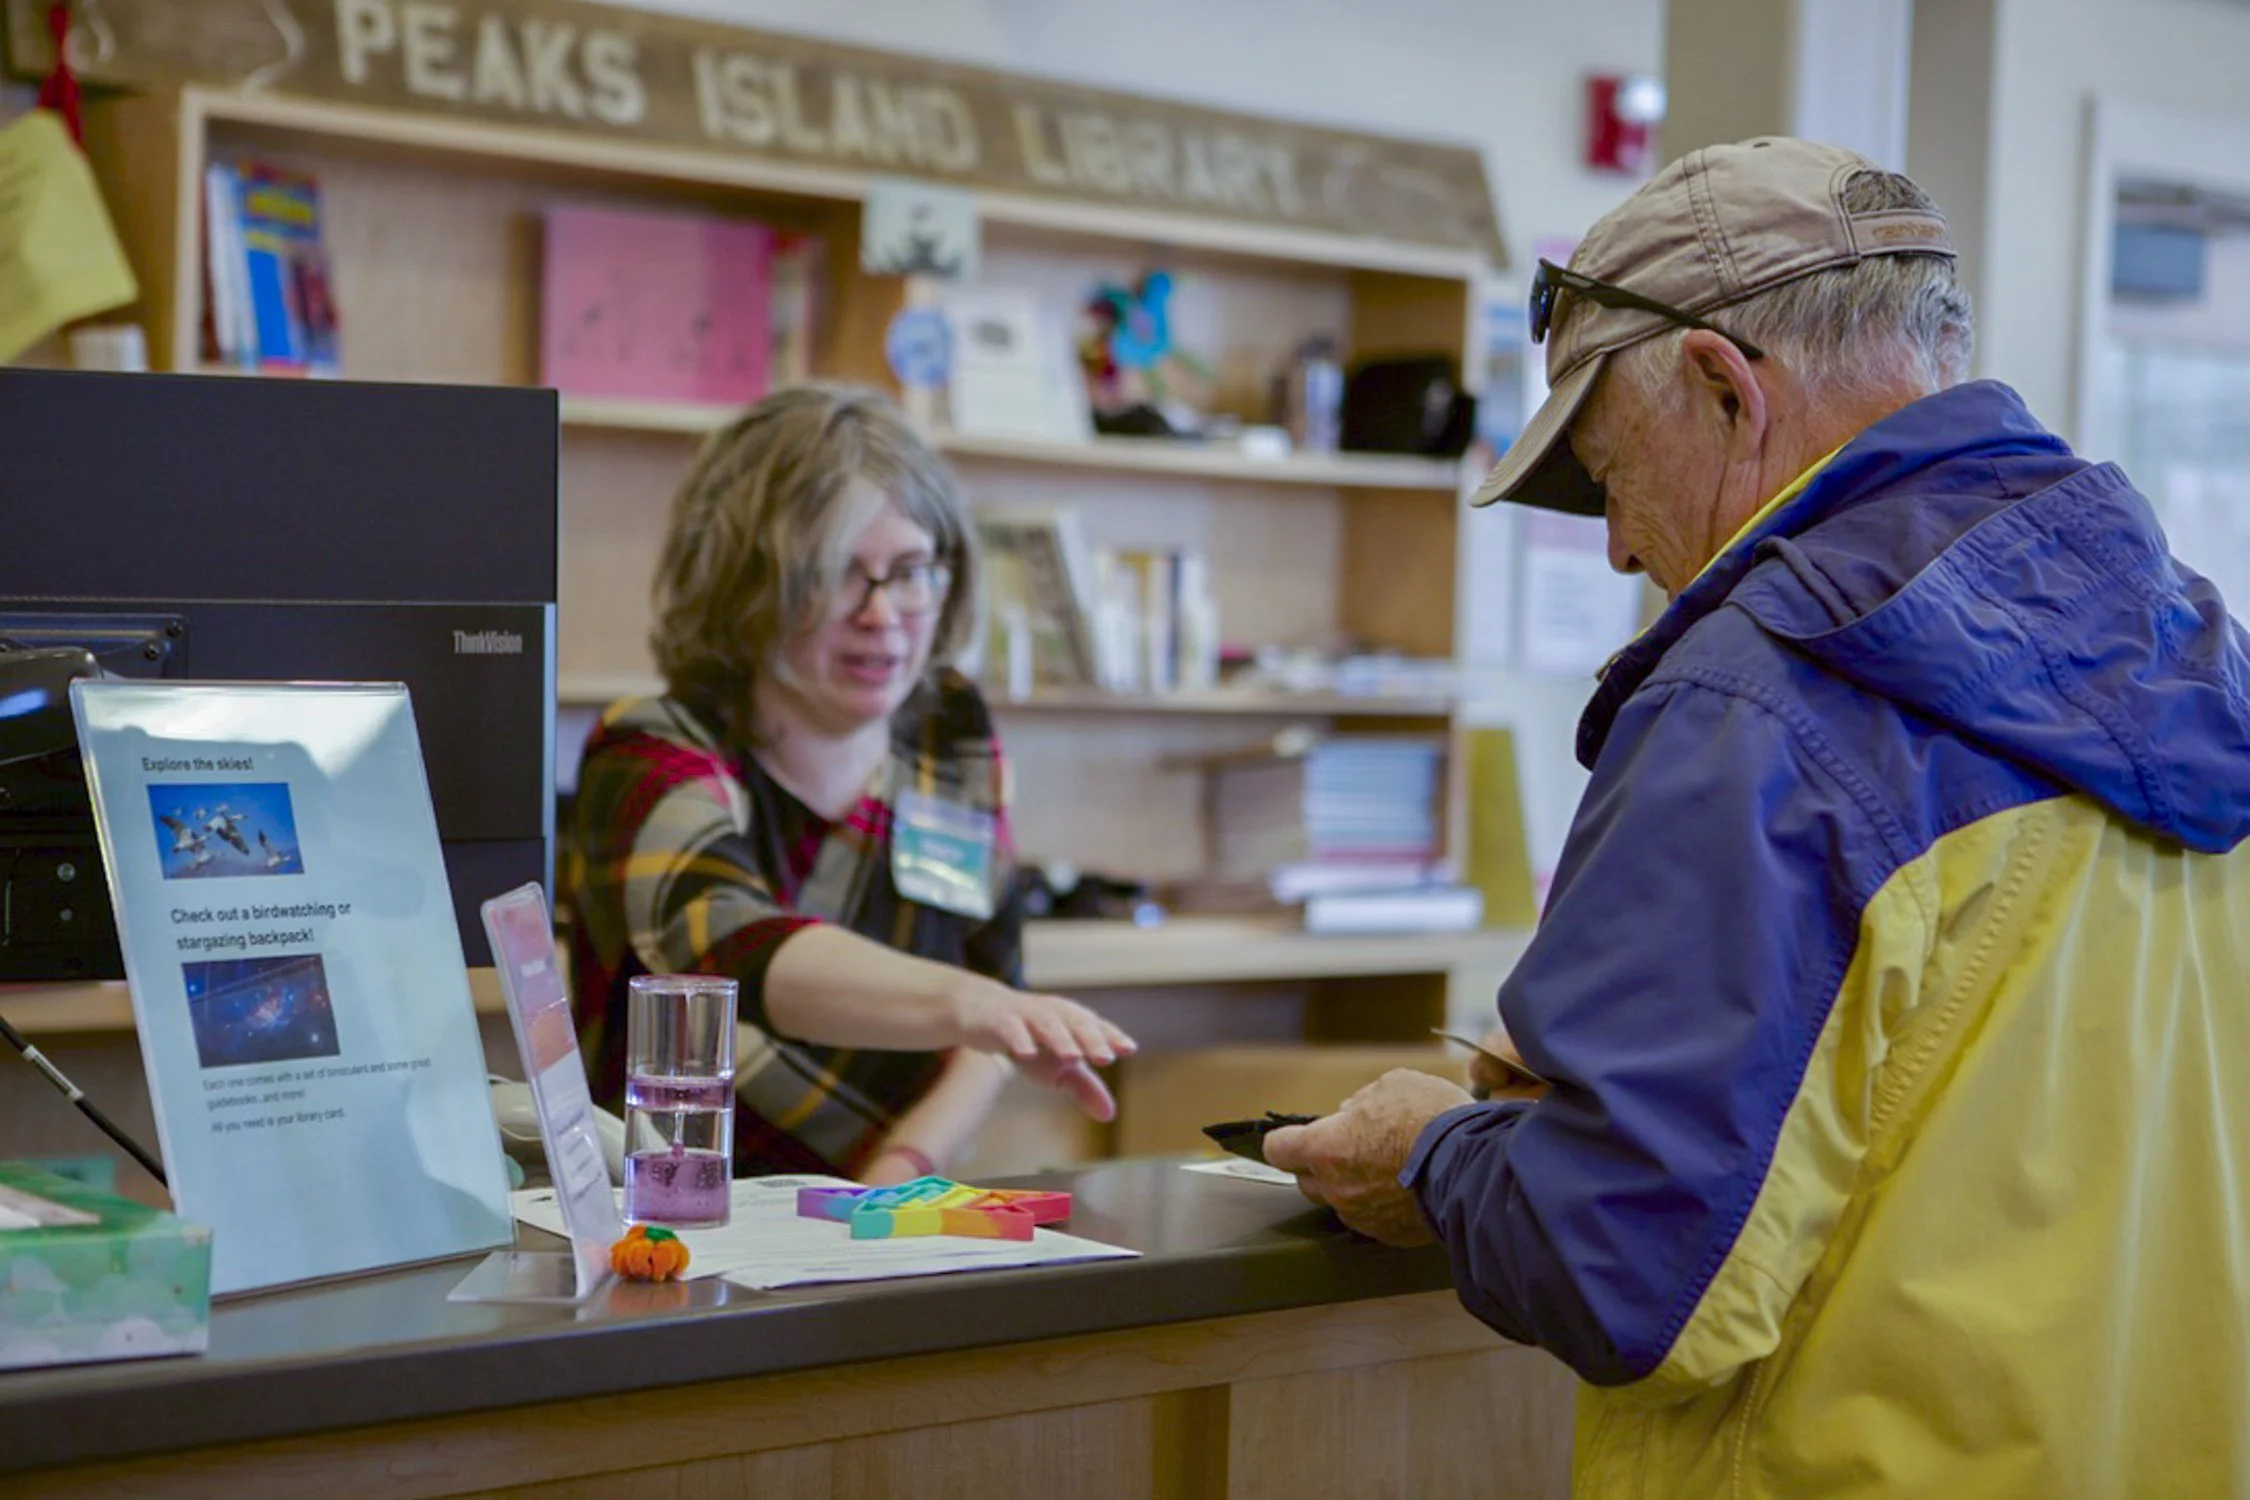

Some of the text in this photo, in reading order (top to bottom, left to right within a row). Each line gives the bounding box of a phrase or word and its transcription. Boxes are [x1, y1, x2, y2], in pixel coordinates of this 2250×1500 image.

[335, 0, 1306, 217] PEAKS ISLAND LIBRARY
[453, 630, 523, 654] ThinkVision
[141, 756, 254, 774] Explore the skies!
[170, 902, 352, 925] Check out a birdwatching or
[176, 928, 315, 952] stargazing backpack!
[202, 1078, 225, 1092] Each
[227, 1079, 244, 1089] one
[246, 1075, 275, 1087] comes
[276, 1072, 293, 1083] with
[302, 1070, 315, 1080] set
[316, 1067, 326, 1079] of
[327, 1064, 368, 1078] binoculars
[370, 1062, 386, 1073] and
[387, 1061, 409, 1071] some
[410, 1057, 431, 1072] great
[263, 1092, 280, 1103] and
[211, 1121, 223, 1132] All
[225, 1121, 241, 1134] you
[242, 1116, 265, 1128] need
[266, 1117, 275, 1127] is
[276, 1114, 294, 1127] your
[295, 1110, 323, 1124] library
